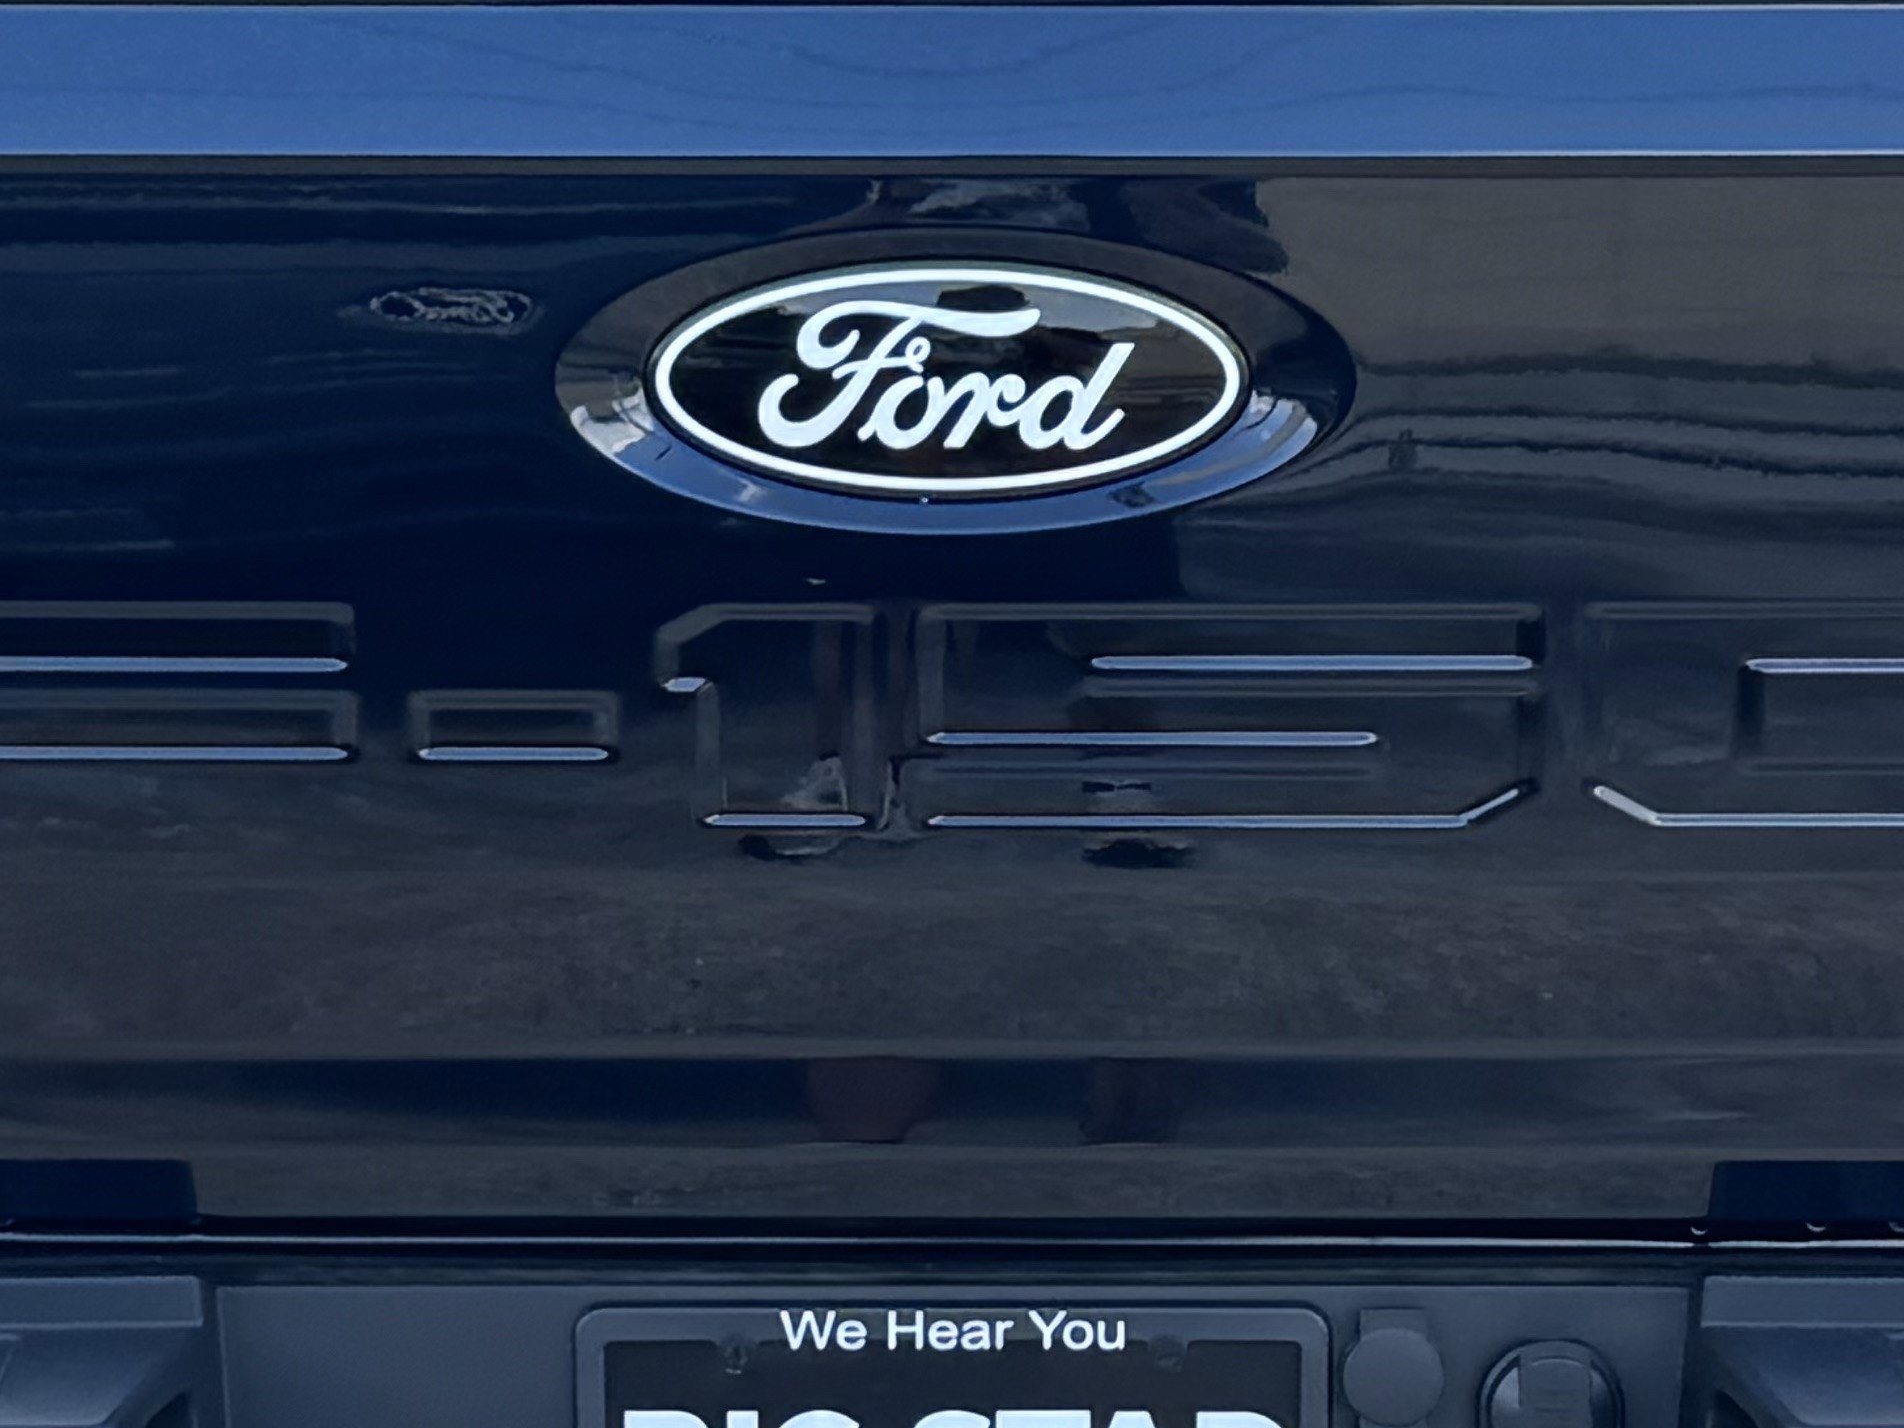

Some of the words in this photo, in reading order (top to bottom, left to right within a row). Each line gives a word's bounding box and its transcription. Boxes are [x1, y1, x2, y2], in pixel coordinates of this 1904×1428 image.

[758, 299, 1135, 450] Ford
[780, 1309, 868, 1351] We
[886, 1309, 1014, 1351] Hear
[1027, 1309, 1127, 1351] You
